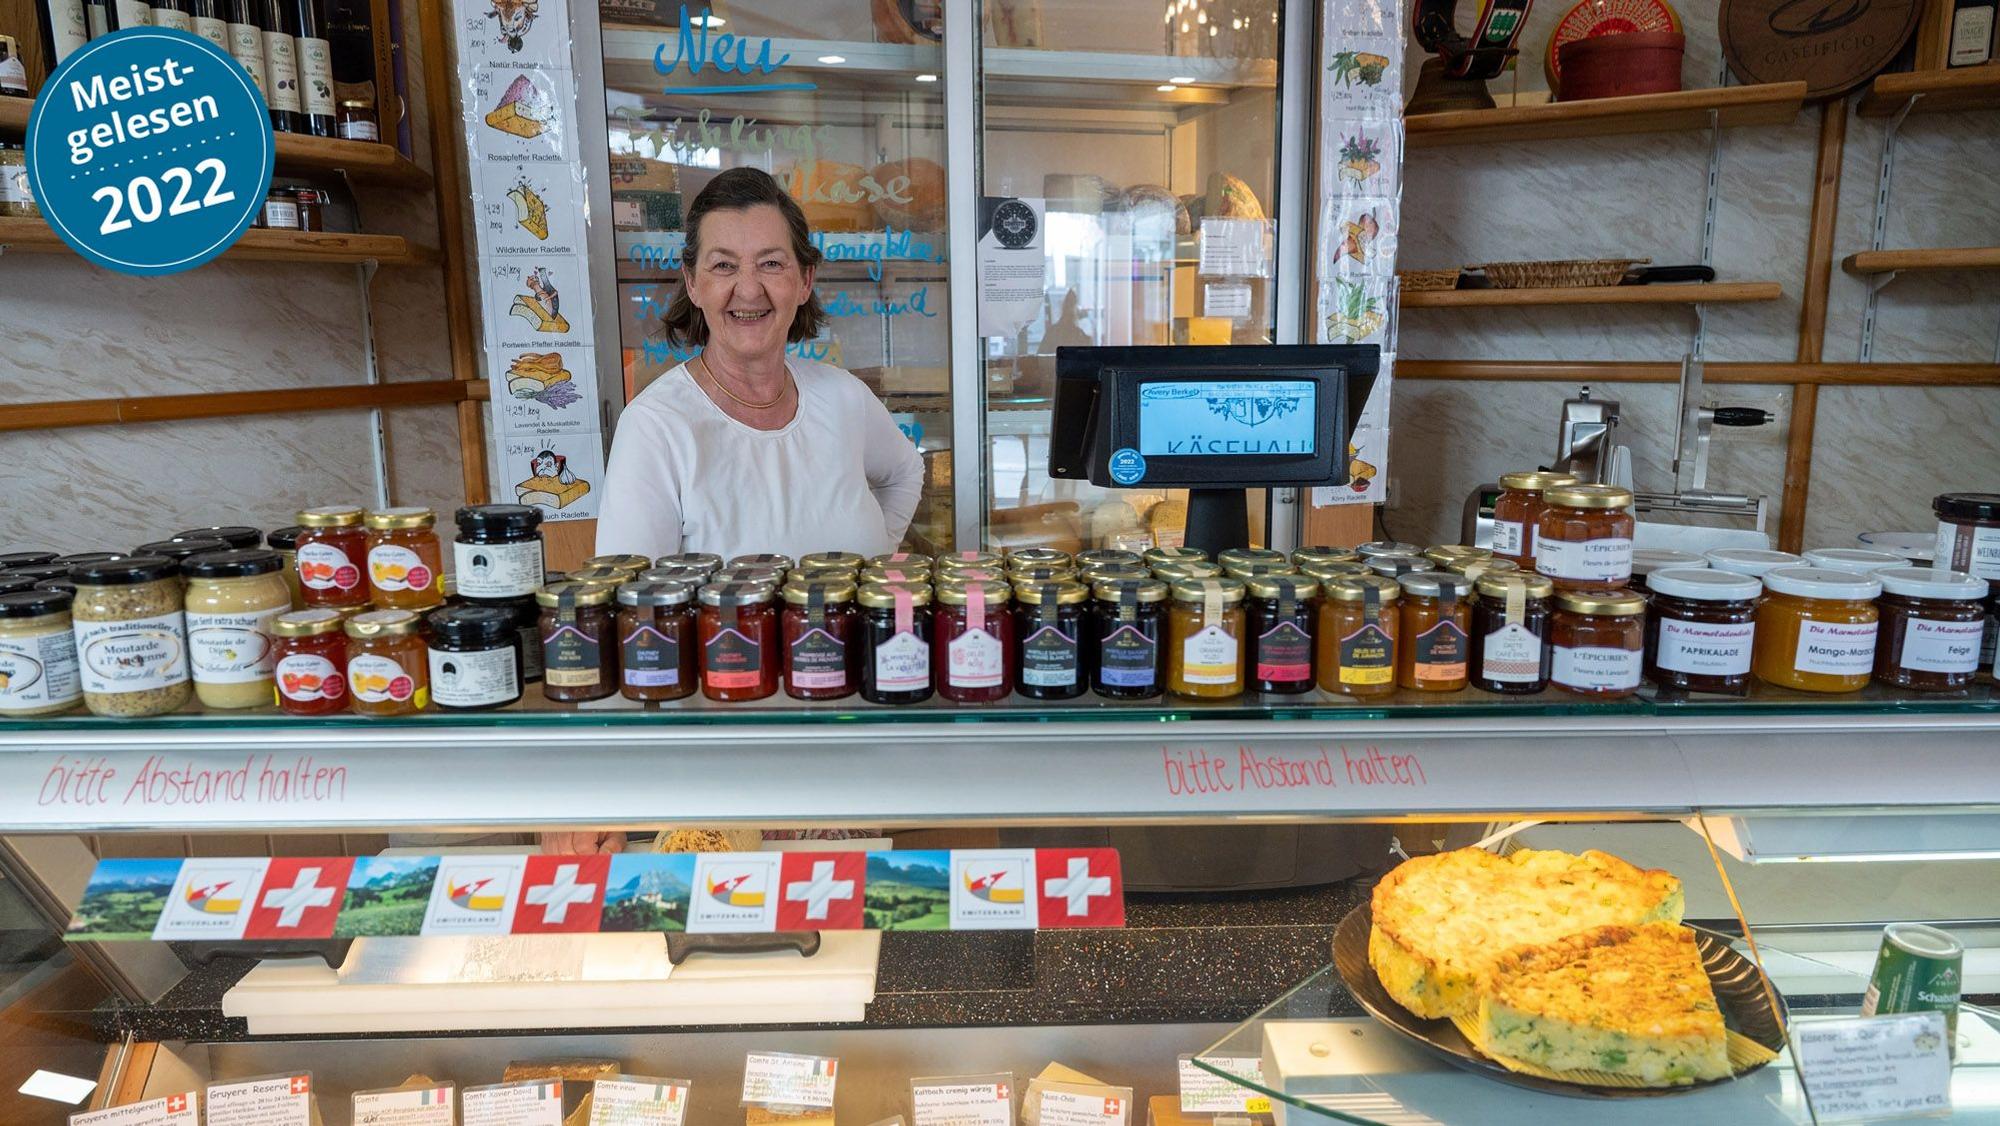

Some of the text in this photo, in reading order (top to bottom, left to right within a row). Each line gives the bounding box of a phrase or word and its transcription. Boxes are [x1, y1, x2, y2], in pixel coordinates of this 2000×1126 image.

[654, 3, 790, 75] Neu
[1763, 35, 1876, 65] CASEIFICIO
[488, 153, 562, 163] Rosapfeffer Raclette
[495, 245, 571, 255] Wildkräuter Raclette
[502, 341, 531, 349] Portwein
[554, 340, 581, 348] Raclette
[514, 421, 541, 429] Lavendel
[561, 511, 590, 519] Raclette
[1667, 624, 1681, 635] Die
[1809, 625, 1825, 635] Die
[1916, 623, 1932, 634] Die
[104, 641, 159, 654] Moutarde
[1681, 646, 1739, 657] PAPRIKALADE
[1948, 645, 1971, 656] Feige
[1163, 744, 1427, 795] bitte Abstand halten
[38, 753, 347, 807] bitte Abstand halten
[962, 909, 1021, 917] SWITZERLAND
[170, 919, 231, 927] SWITZERLAND
[436, 916, 496, 924] SWITZERLAND
[209, 1082, 290, 1099] Gruyere Reserve
[489, 1089, 512, 1098] Xavier
[513, 1087, 532, 1096] David
[915, 1086, 992, 1097] Kaltbach cremig würzig
[110, 1100, 166, 1117] mittelgereift
[73, 1114, 109, 1126] Gruyere
